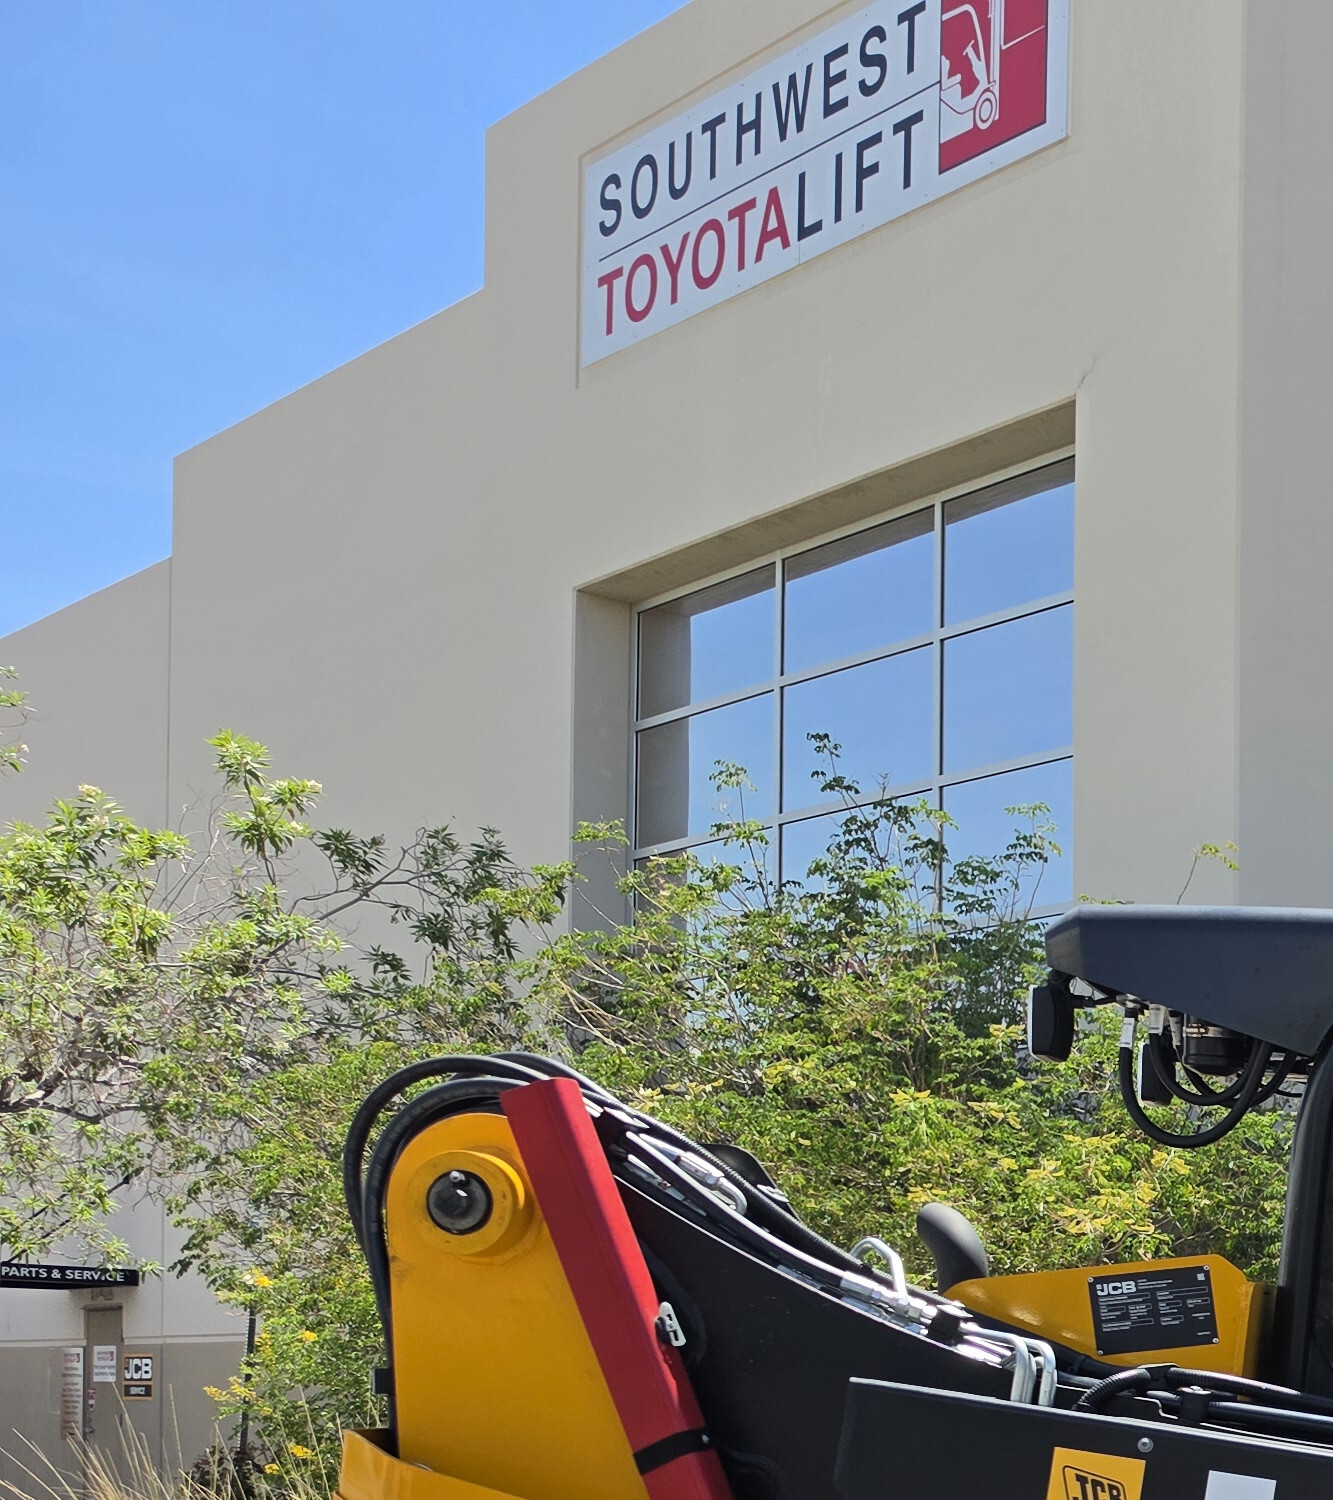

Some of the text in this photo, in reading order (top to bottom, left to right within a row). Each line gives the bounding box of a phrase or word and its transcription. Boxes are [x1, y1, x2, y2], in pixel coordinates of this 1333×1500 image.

[599, 2, 927, 237] SOUTHWEST
[597, 109, 924, 336] TOYOTALIFT
[1, 1266, 48, 1278] PARTS
[51, 1269, 61, 1279] &
[1096, 1281, 1136, 1296] JCB
[125, 1358, 152, 1379] JCB
